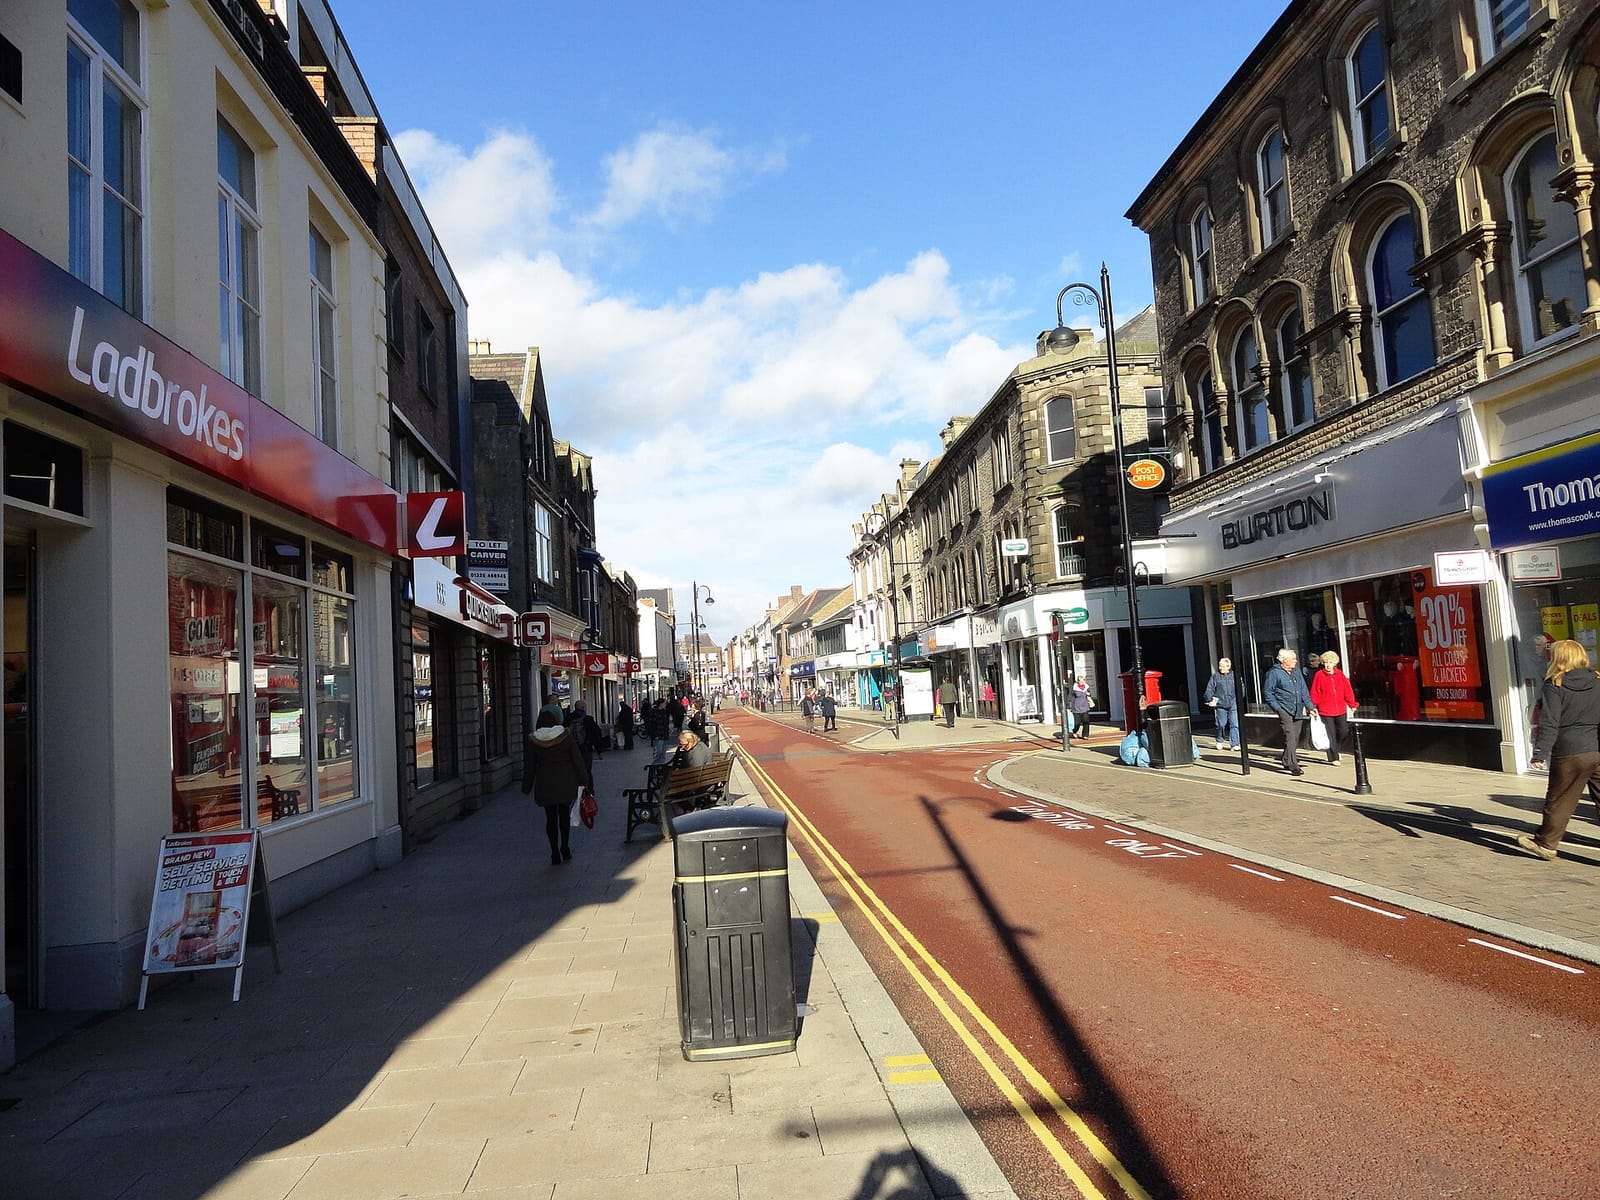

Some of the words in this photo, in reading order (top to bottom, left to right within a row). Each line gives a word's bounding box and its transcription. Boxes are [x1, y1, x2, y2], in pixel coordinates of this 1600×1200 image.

[68, 306, 244, 461] Ladbrokes
[1132, 474, 1160, 482] OFFICE
[1136, 466, 1155, 474] POST
[1221, 490, 1331, 549] BURTON
[470, 551, 507, 559] CARVER
[1420, 592, 1466, 650] 30%
[1574, 612, 1598, 623] DEALS
[189, 617, 219, 642] GOAL!
[1453, 628, 1467, 647] OFF
[1432, 651, 1442, 667] ALL
[1444, 649, 1466, 667] COATS
[1440, 666, 1467, 682] JACKETS
[1104, 838, 1187, 858] ONLY
[165, 853, 191, 865] BRAND
[193, 850, 211, 860] NEW
[163, 864, 194, 880] SELF
[195, 854, 246, 874] SERVICE
[219, 868, 243, 879] TOUCH
[161, 872, 213, 891] BETTING
[225, 876, 241, 885] BET
